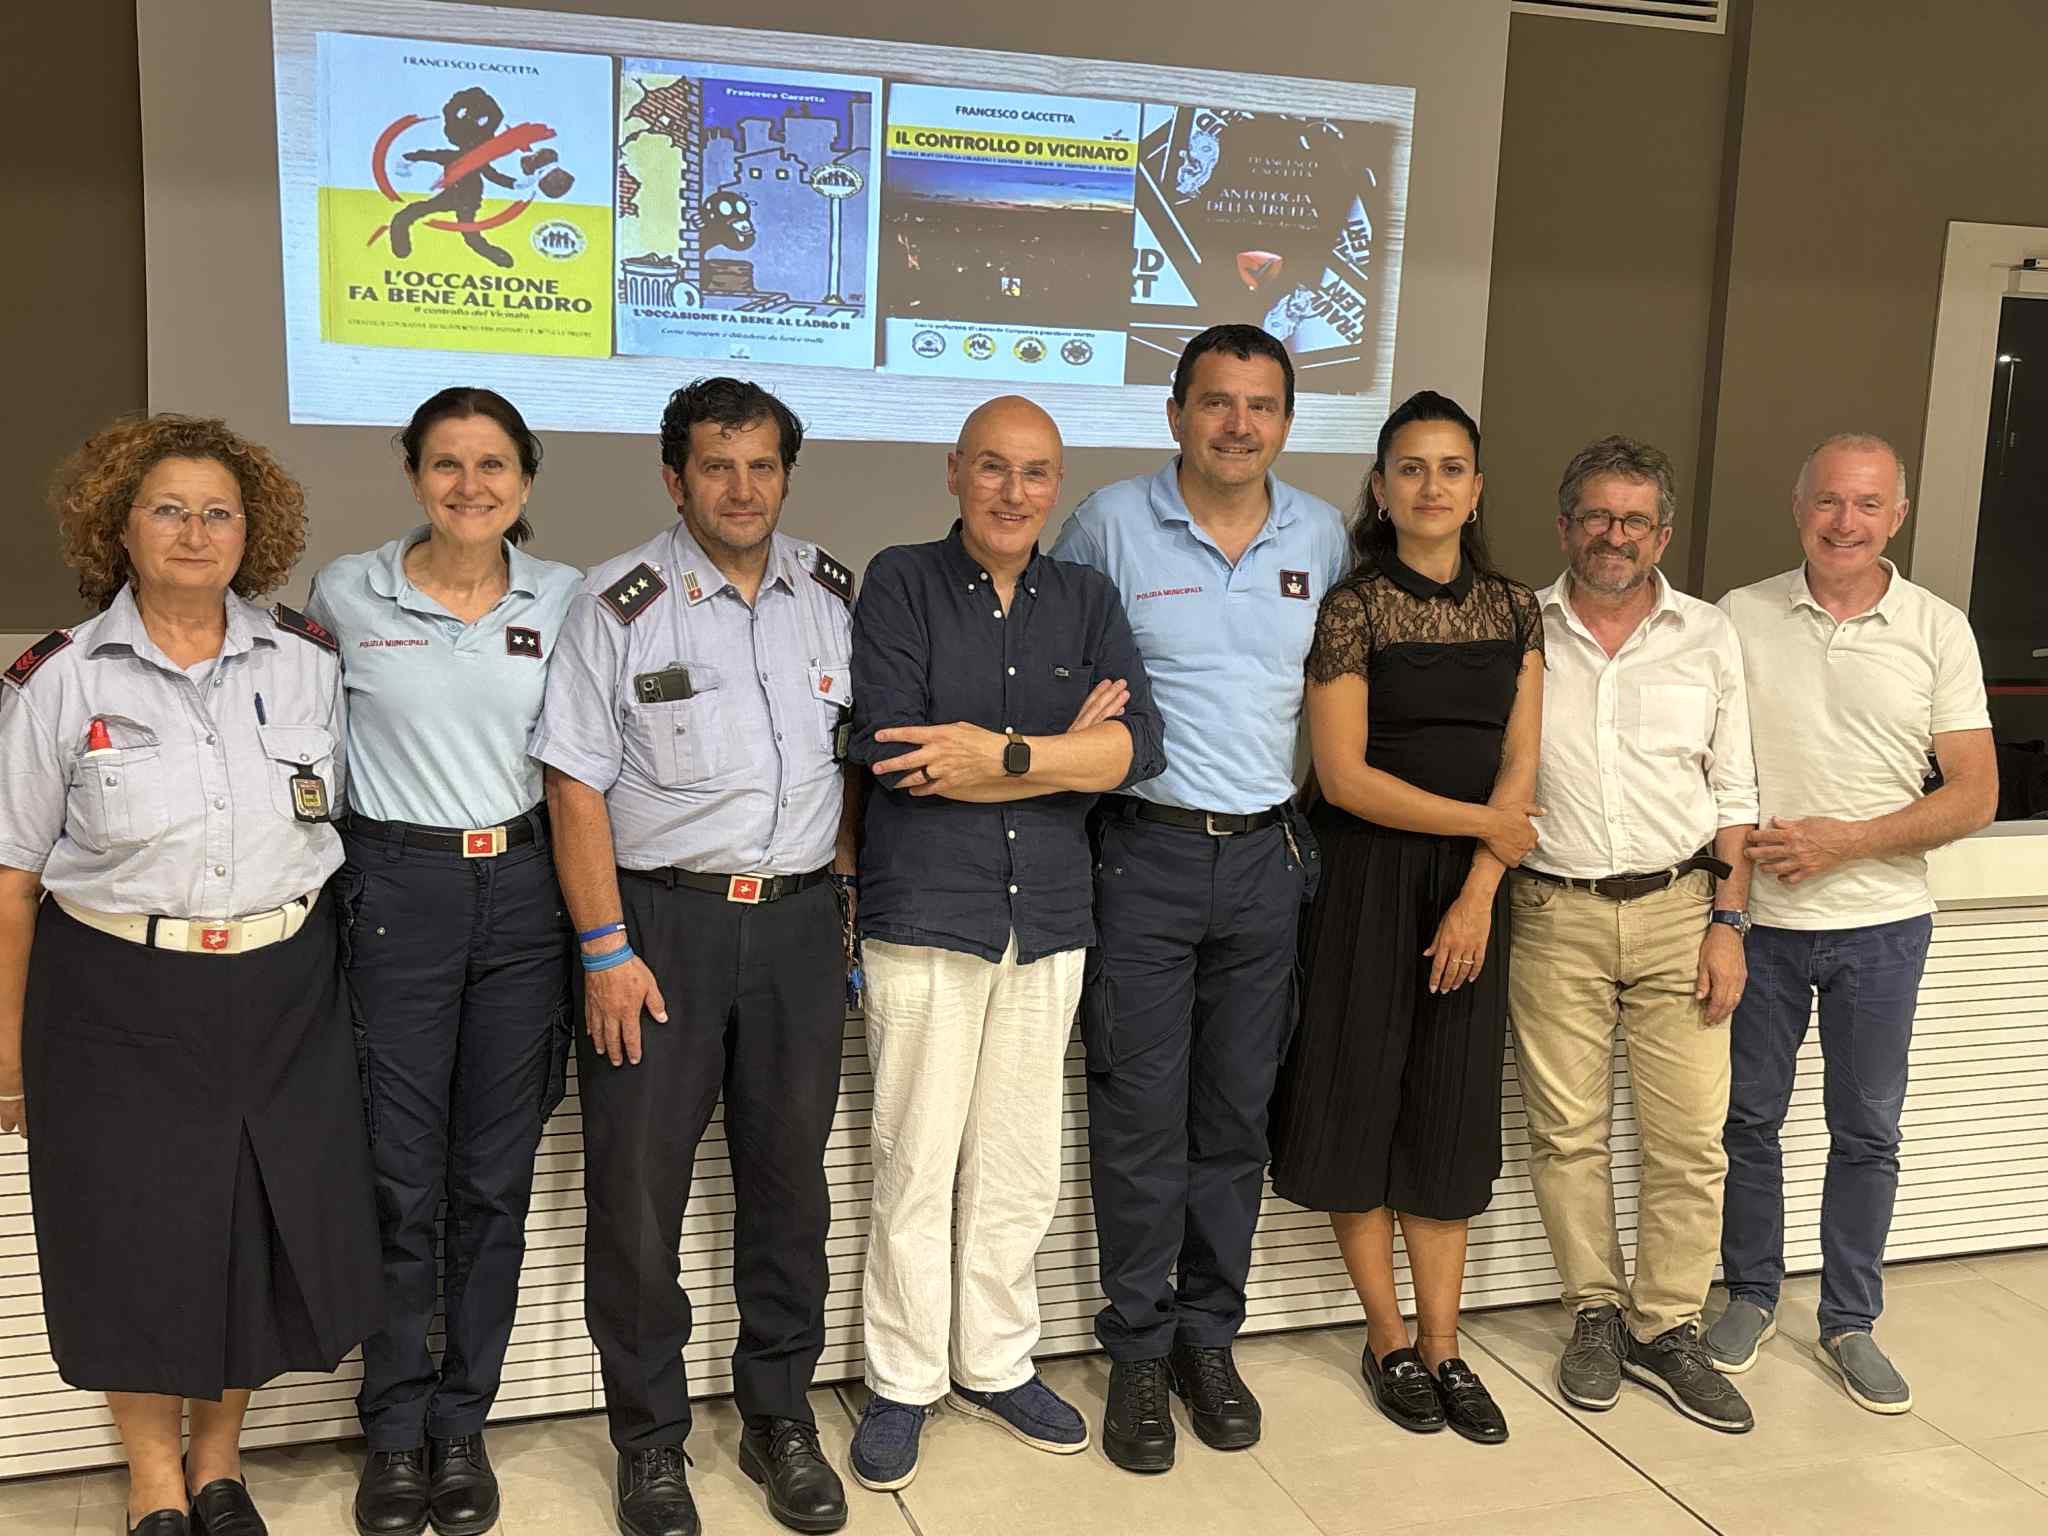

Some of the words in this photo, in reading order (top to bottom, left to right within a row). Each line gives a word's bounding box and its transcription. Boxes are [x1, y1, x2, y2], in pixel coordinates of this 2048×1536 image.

[403, 55, 477, 71] FRANCESCO
[479, 62, 540, 76] CACCETTA
[725, 87, 778, 99] Francesco
[779, 92, 826, 103] Caccetta
[955, 105, 1019, 120] FRANCESCO
[1021, 110, 1076, 124] CACCETTA
[895, 130, 911, 145] IL
[914, 132, 1021, 154] CONTROLLO
[1024, 140, 1044, 155] DI
[1046, 142, 1129, 162] VICINATO
[1219, 188, 1312, 204] ANTOLOGIA
[384, 269, 560, 295] L'OCCASIONE
[348, 285, 379, 302] FA
[387, 287, 456, 306] BENE
[462, 291, 495, 308] AL
[503, 293, 593, 313] LADRO
[632, 308, 719, 321] L'OCCASIONE
[720, 314, 738, 323] FA
[740, 315, 774, 325] BENE
[776, 317, 793, 327] AL
[795, 318, 839, 330] LADRO
[840, 321, 851, 330] II
[1136, 590, 1163, 601] POLIZIA
[1163, 586, 1202, 596] MUNICIPALE
[359, 639, 384, 649] POLIZIA
[384, 639, 429, 648] MUNICIPALE
